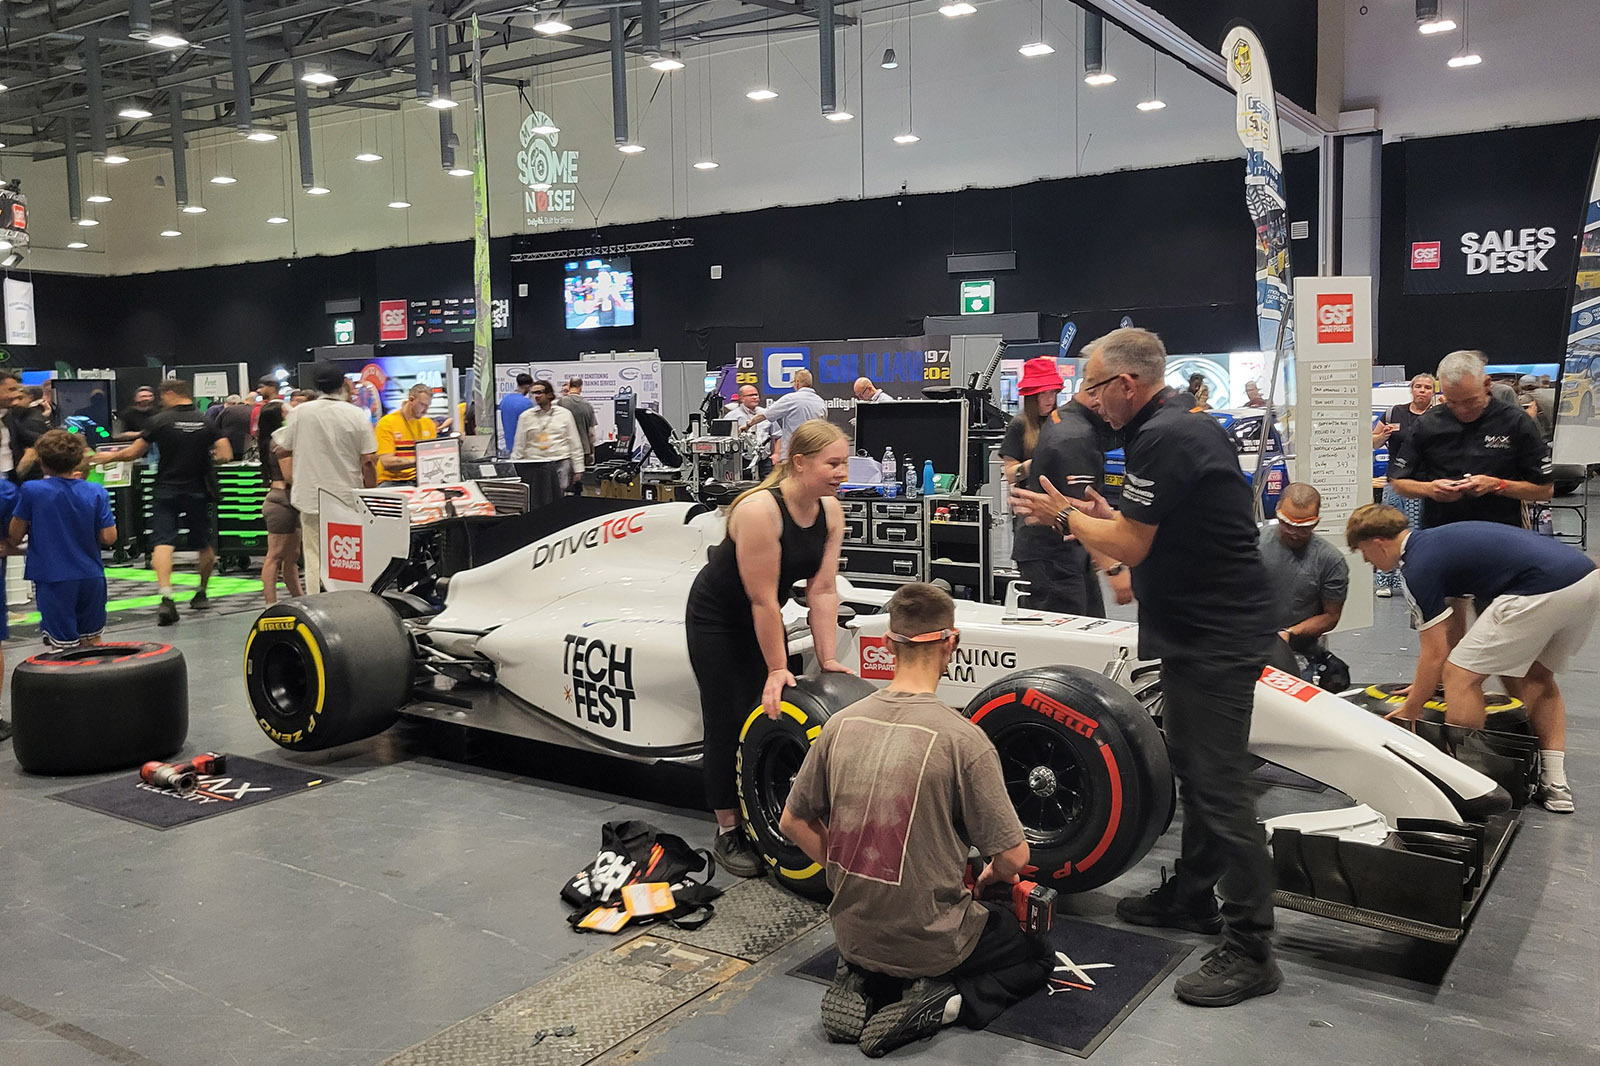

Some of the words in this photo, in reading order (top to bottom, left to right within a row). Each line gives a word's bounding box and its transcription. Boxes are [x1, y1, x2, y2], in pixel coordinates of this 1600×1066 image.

[517, 149, 579, 185] SOME
[525, 189, 575, 213] NOISE!
[1460, 227, 1556, 254] SALES
[1414, 248, 1438, 259] GSF
[1467, 249, 1549, 275] DESK
[382, 309, 405, 326] GSF
[1319, 304, 1353, 325] GSF
[924, 350, 951, 363] 197
[923, 367, 950, 380] 202
[330, 535, 360, 560] GSF
[330, 558, 344, 567] CAR
[344, 559, 361, 570] PARTS
[257, 616, 297, 632] PIRELLI
[563, 634, 634, 690] TECH
[863, 663, 878, 671] CAR
[955, 648, 1017, 669] NING
[941, 665, 976, 683] AM
[573, 677, 636, 732] FEST
[1022, 688, 1099, 739] PIRELLI
[258, 718, 303, 743] ZERO
